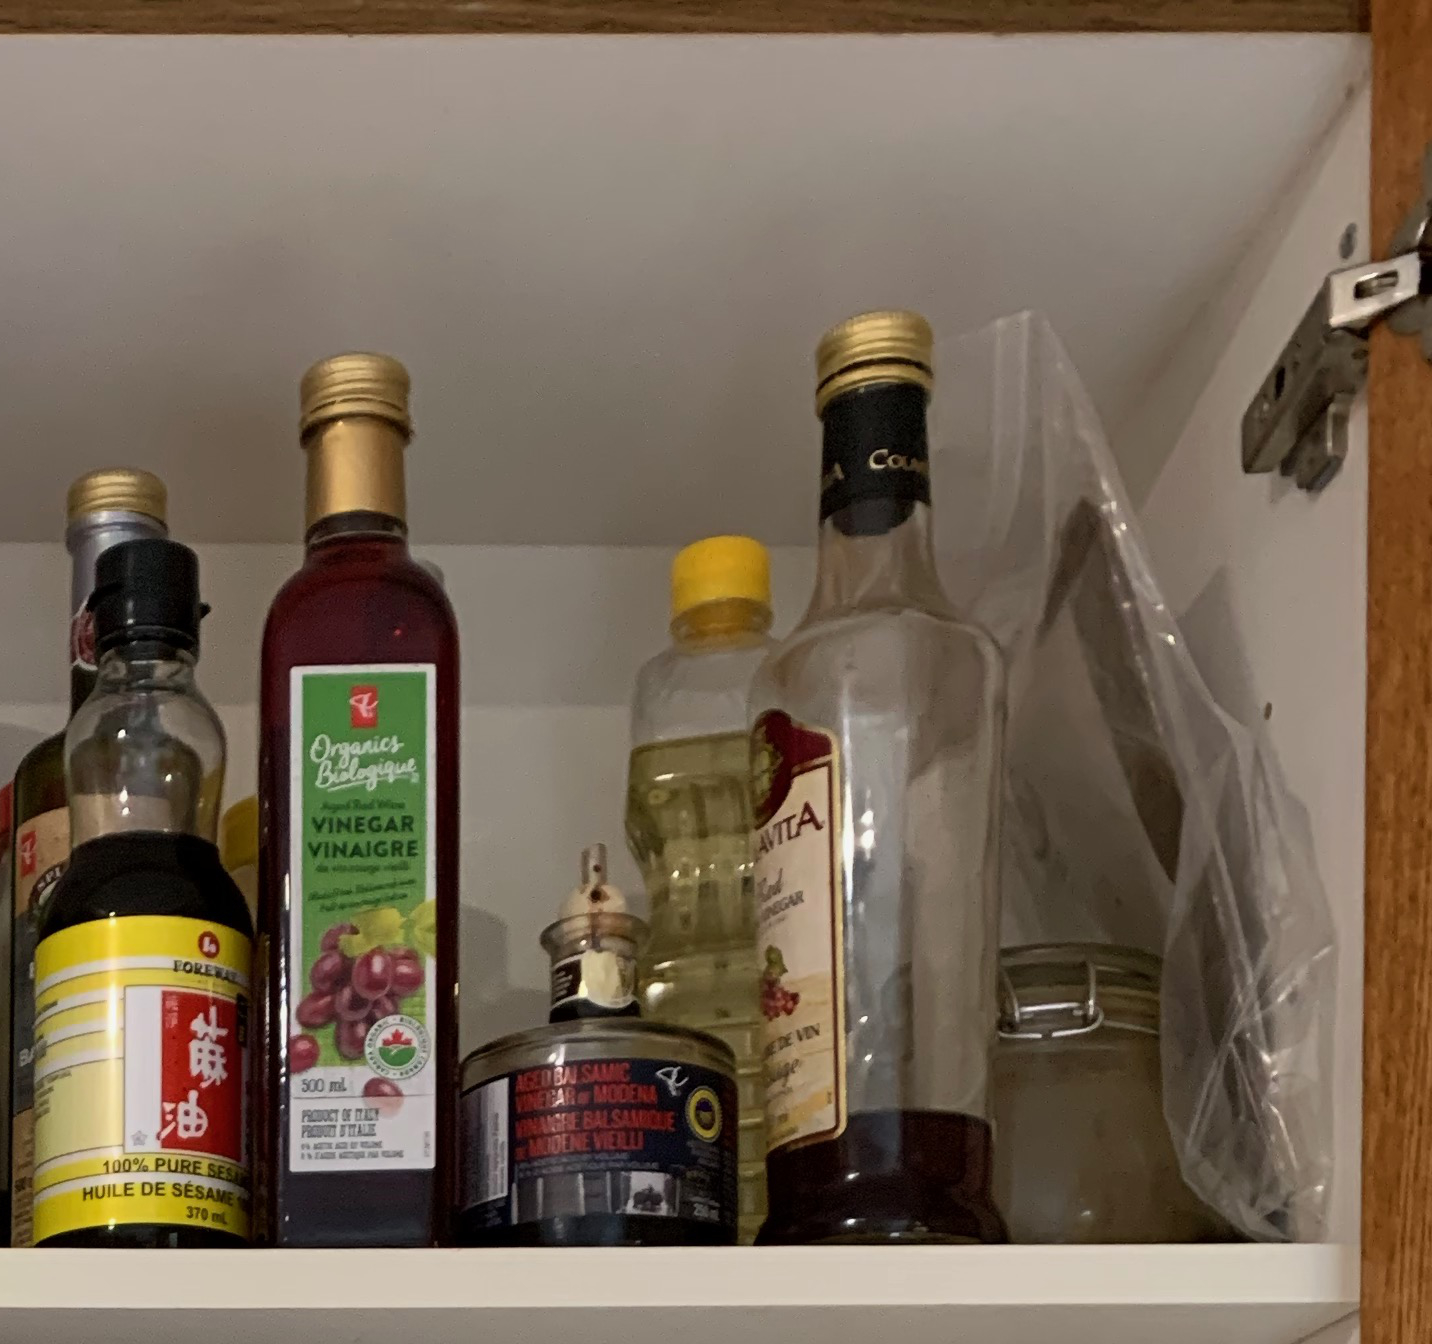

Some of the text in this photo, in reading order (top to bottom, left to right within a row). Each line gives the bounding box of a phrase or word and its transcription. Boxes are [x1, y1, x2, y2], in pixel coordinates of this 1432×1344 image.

[310, 734, 404, 768] Organics
[316, 758, 416, 791] Biologique
[311, 815, 414, 834] VINEGAR
[307, 840, 419, 859] VINAIGRE
[301, 1078, 324, 1093] 500
[301, 1108, 379, 1122] PRODUCT OF ITALY
[301, 1124, 336, 1138] PRODUIT
[103, 1158, 148, 1174] 100%
[155, 1158, 202, 1175] PURE
[82, 1180, 235, 1207] HUILE DE SÉSAME
[186, 1206, 209, 1221] 370
